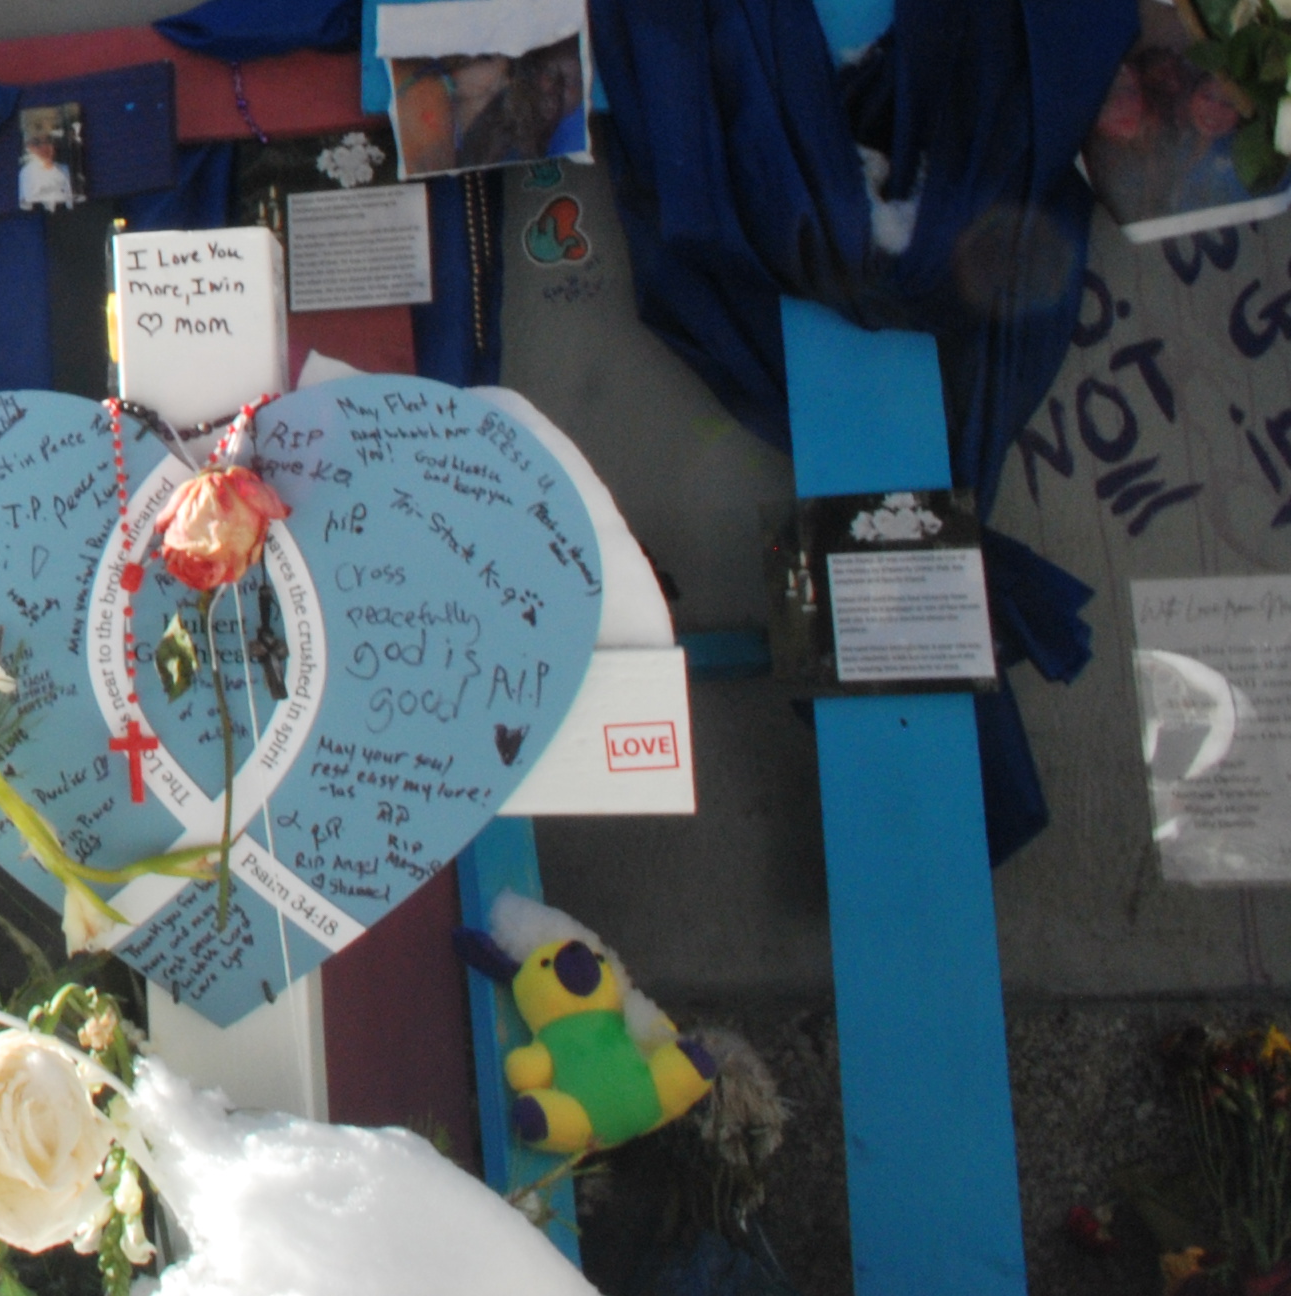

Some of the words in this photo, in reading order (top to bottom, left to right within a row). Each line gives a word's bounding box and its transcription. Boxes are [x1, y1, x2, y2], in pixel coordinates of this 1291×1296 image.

[127, 249, 148, 271] I
[157, 248, 202, 269] Love
[207, 241, 243, 261] You
[266, 421, 325, 450] RIP
[289, 585, 307, 612] the
[98, 606, 113, 641] the
[99, 642, 112, 658] to
[297, 616, 317, 699] crushed
[101, 667, 125, 709] near
[291, 703, 307, 722] in
[259, 721, 297, 769] spirit
[610, 736, 672, 757] LOVE
[161, 769, 191, 807] The
[290, 893, 340, 937] 34:18
